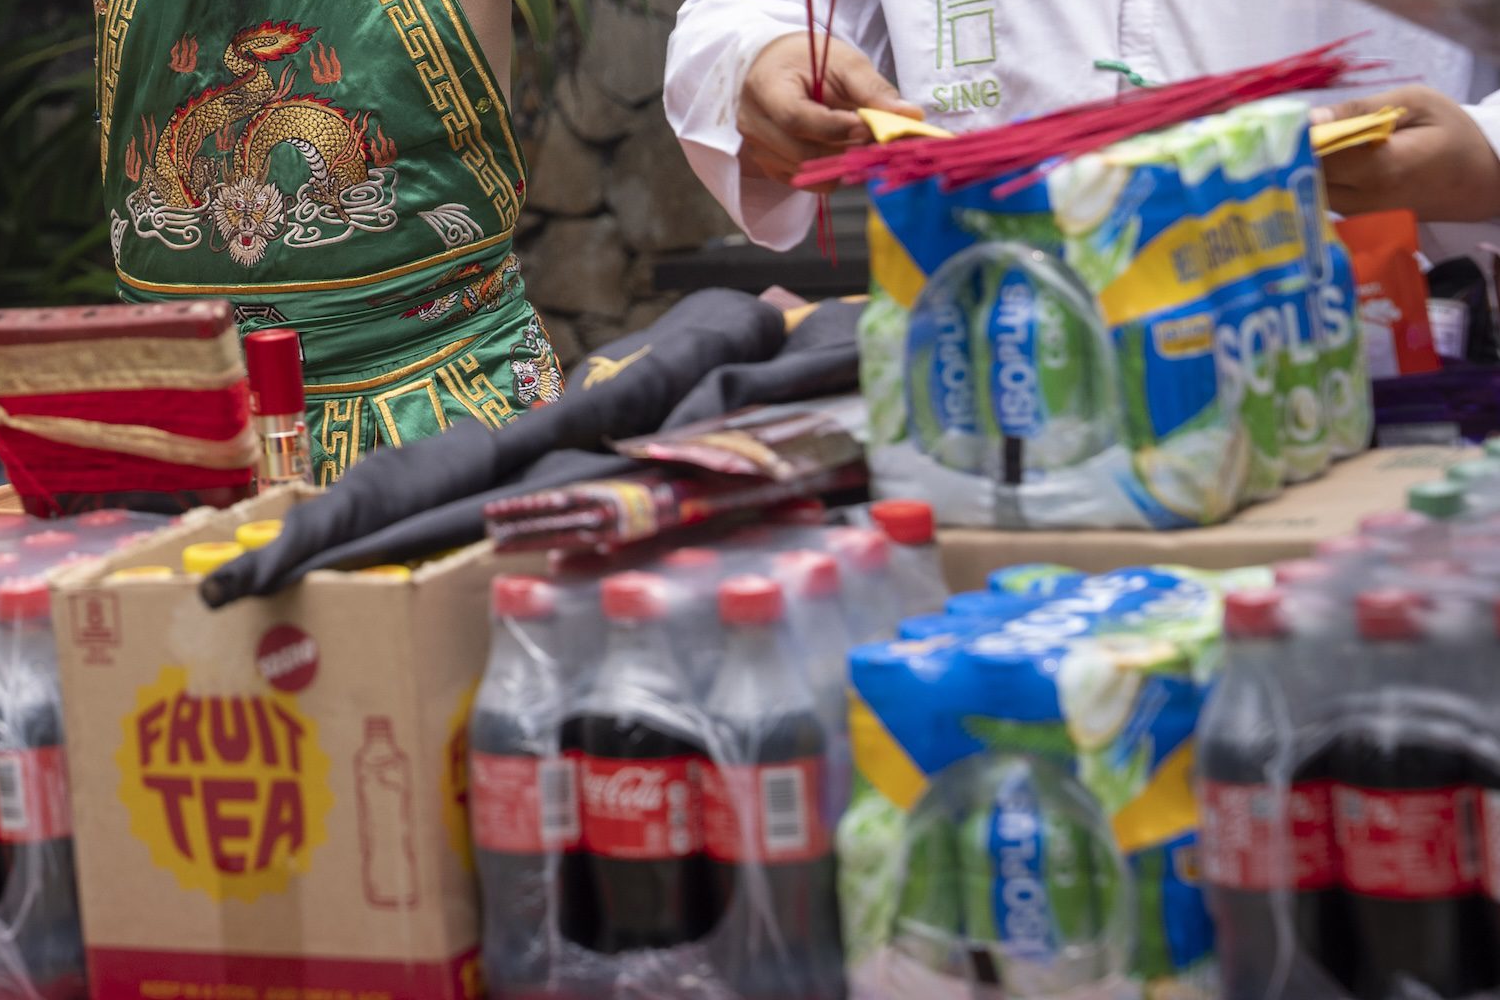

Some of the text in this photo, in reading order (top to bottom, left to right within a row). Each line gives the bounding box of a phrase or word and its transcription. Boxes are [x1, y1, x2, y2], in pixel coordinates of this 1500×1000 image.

[932, 79, 1000, 112] SING
[996, 284, 1037, 427] ISOPLUS
[137, 689, 306, 774] FRUIT
[142, 775, 306, 874] TEA
